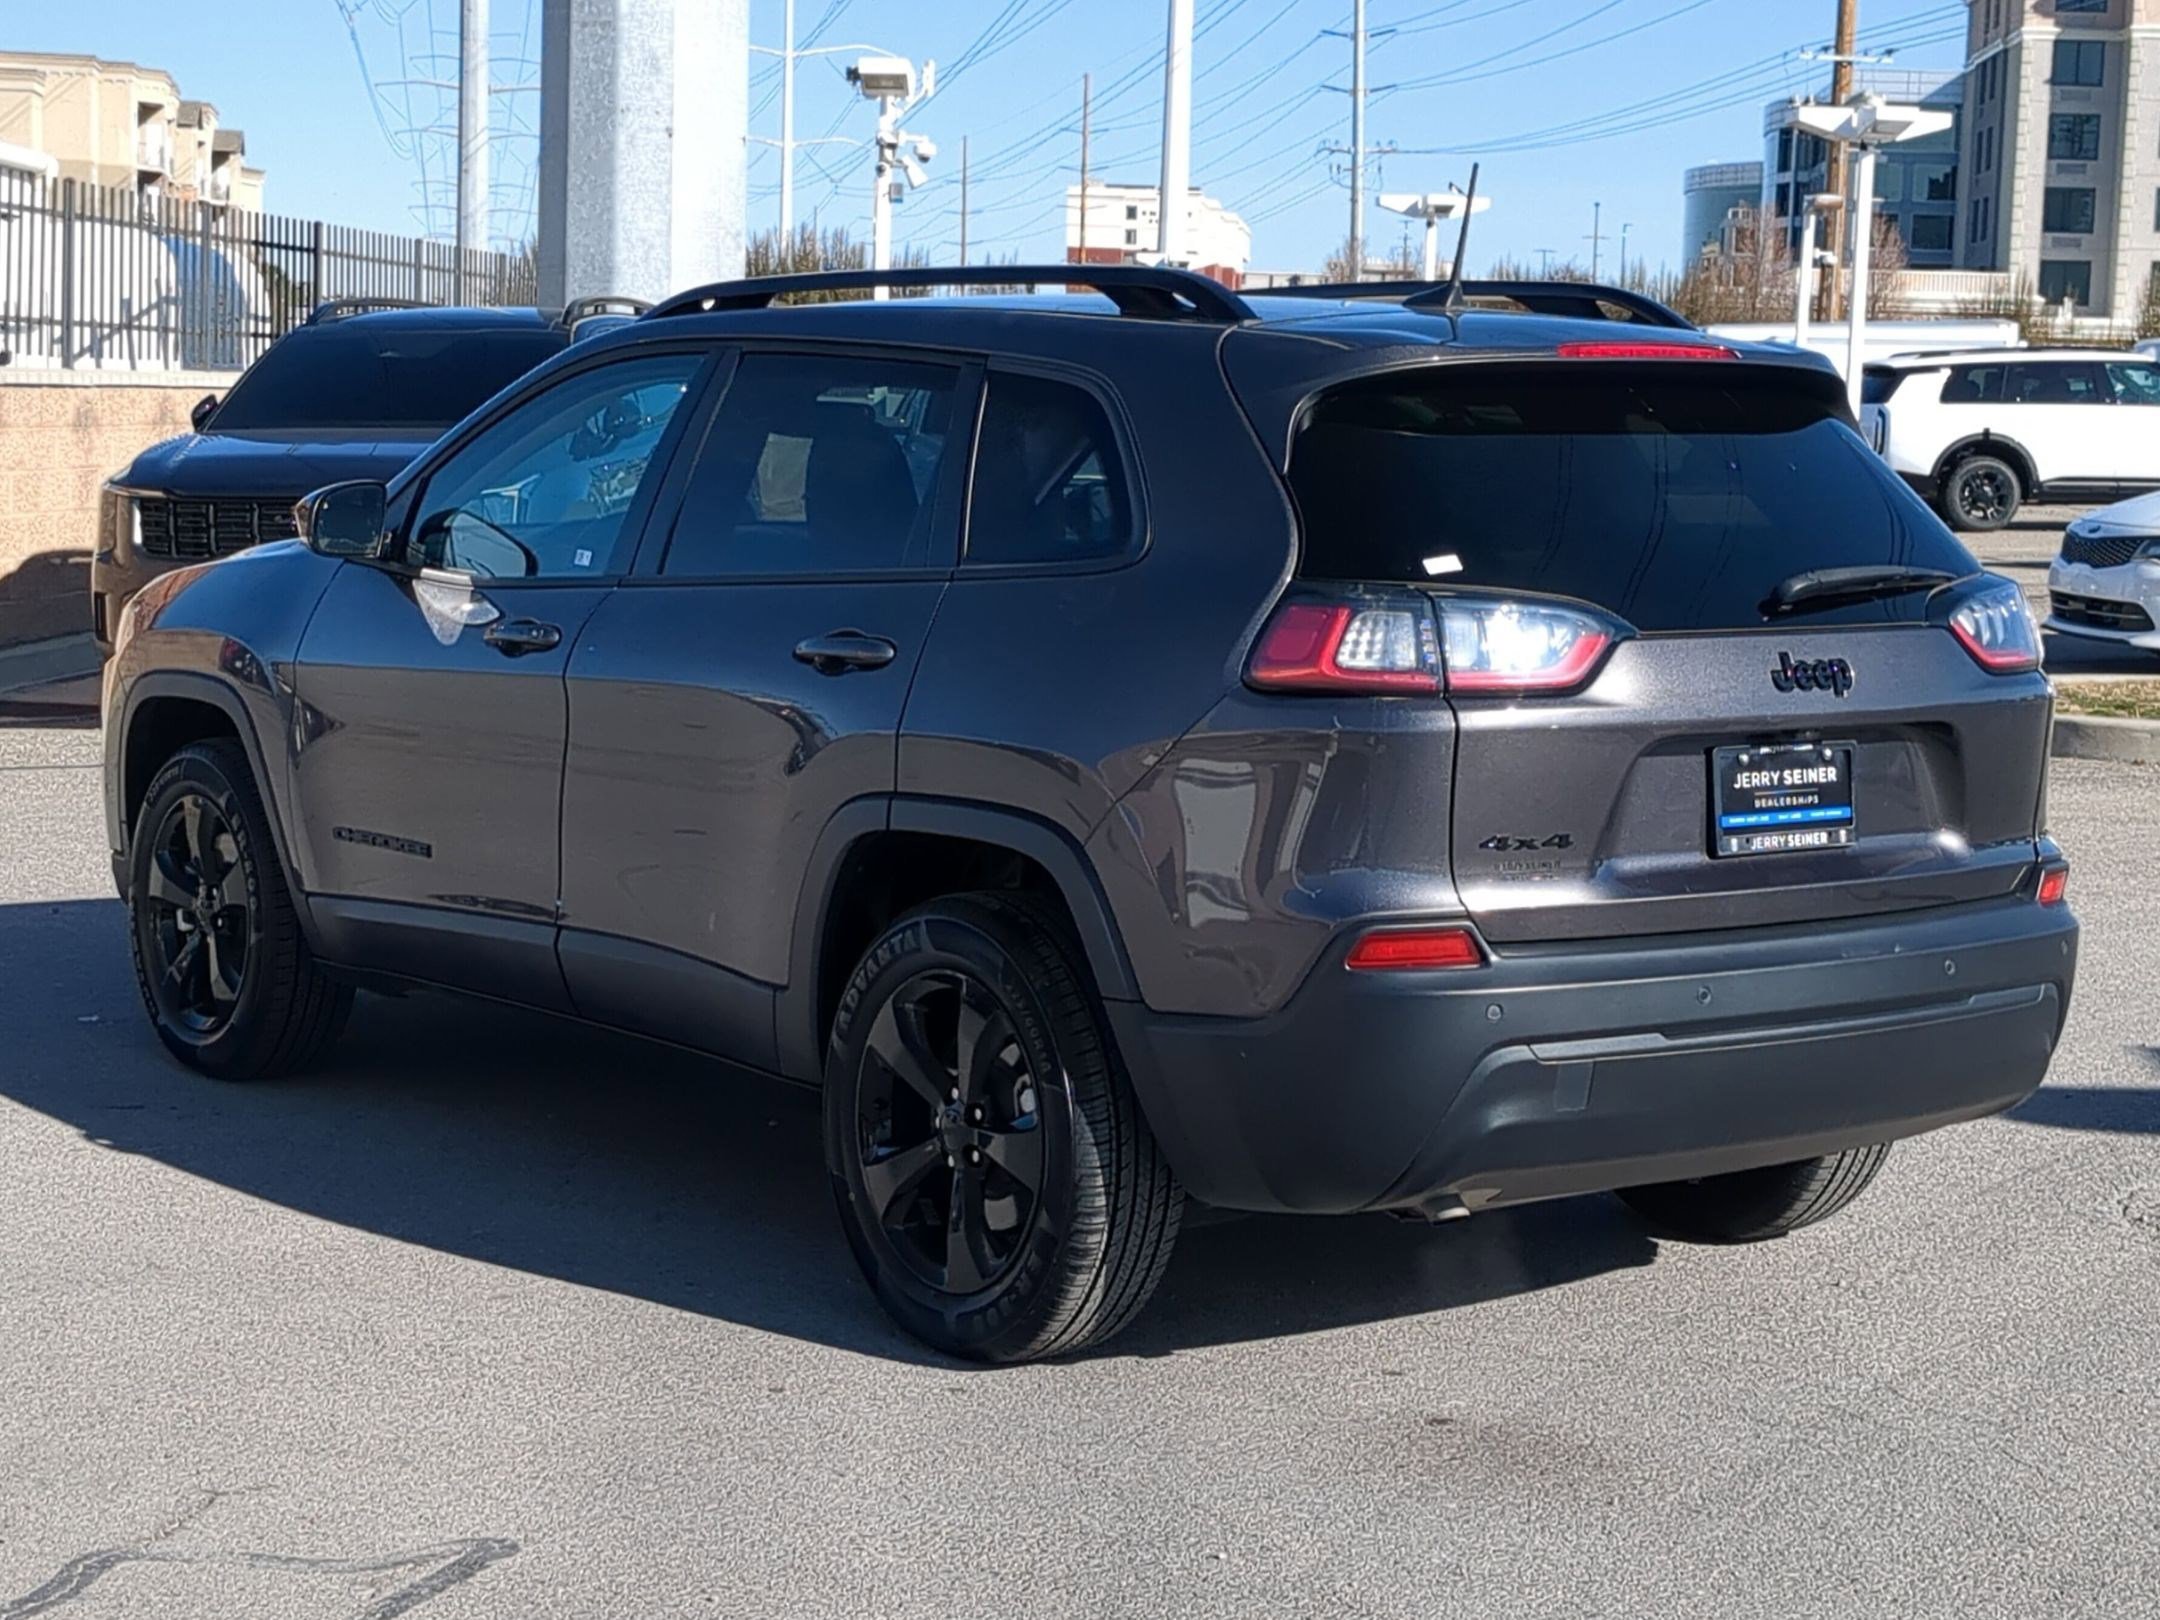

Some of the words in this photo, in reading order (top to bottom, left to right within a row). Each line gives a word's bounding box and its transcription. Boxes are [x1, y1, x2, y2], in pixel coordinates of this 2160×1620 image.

[1770, 651, 1854, 698] Jeep
[1733, 770, 1781, 789] JERRY
[1783, 766, 1837, 785] SEINER
[1754, 794, 1819, 808] DEALERSHIPS
[1479, 833, 1575, 851] 4x4
[1751, 836, 1786, 850] JERRY
[1787, 831, 1828, 847] SEINER
